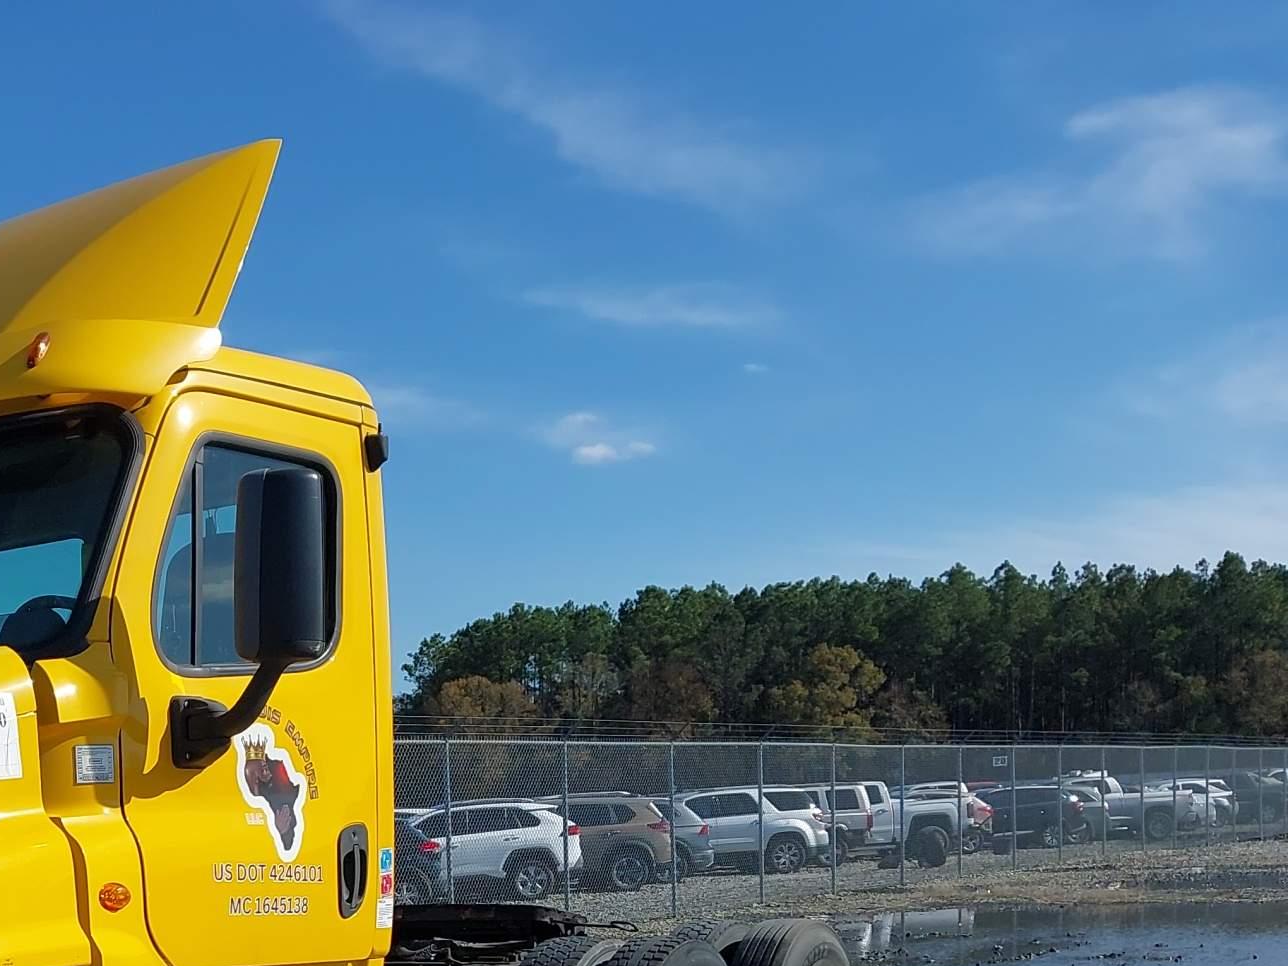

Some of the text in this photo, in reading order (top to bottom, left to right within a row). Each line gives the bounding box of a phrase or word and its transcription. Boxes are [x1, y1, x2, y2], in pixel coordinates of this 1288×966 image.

[284, 719, 319, 800] EMPIRE
[213, 863, 324, 883] US DOT 4246101
[229, 896, 309, 915] MC 1645138
